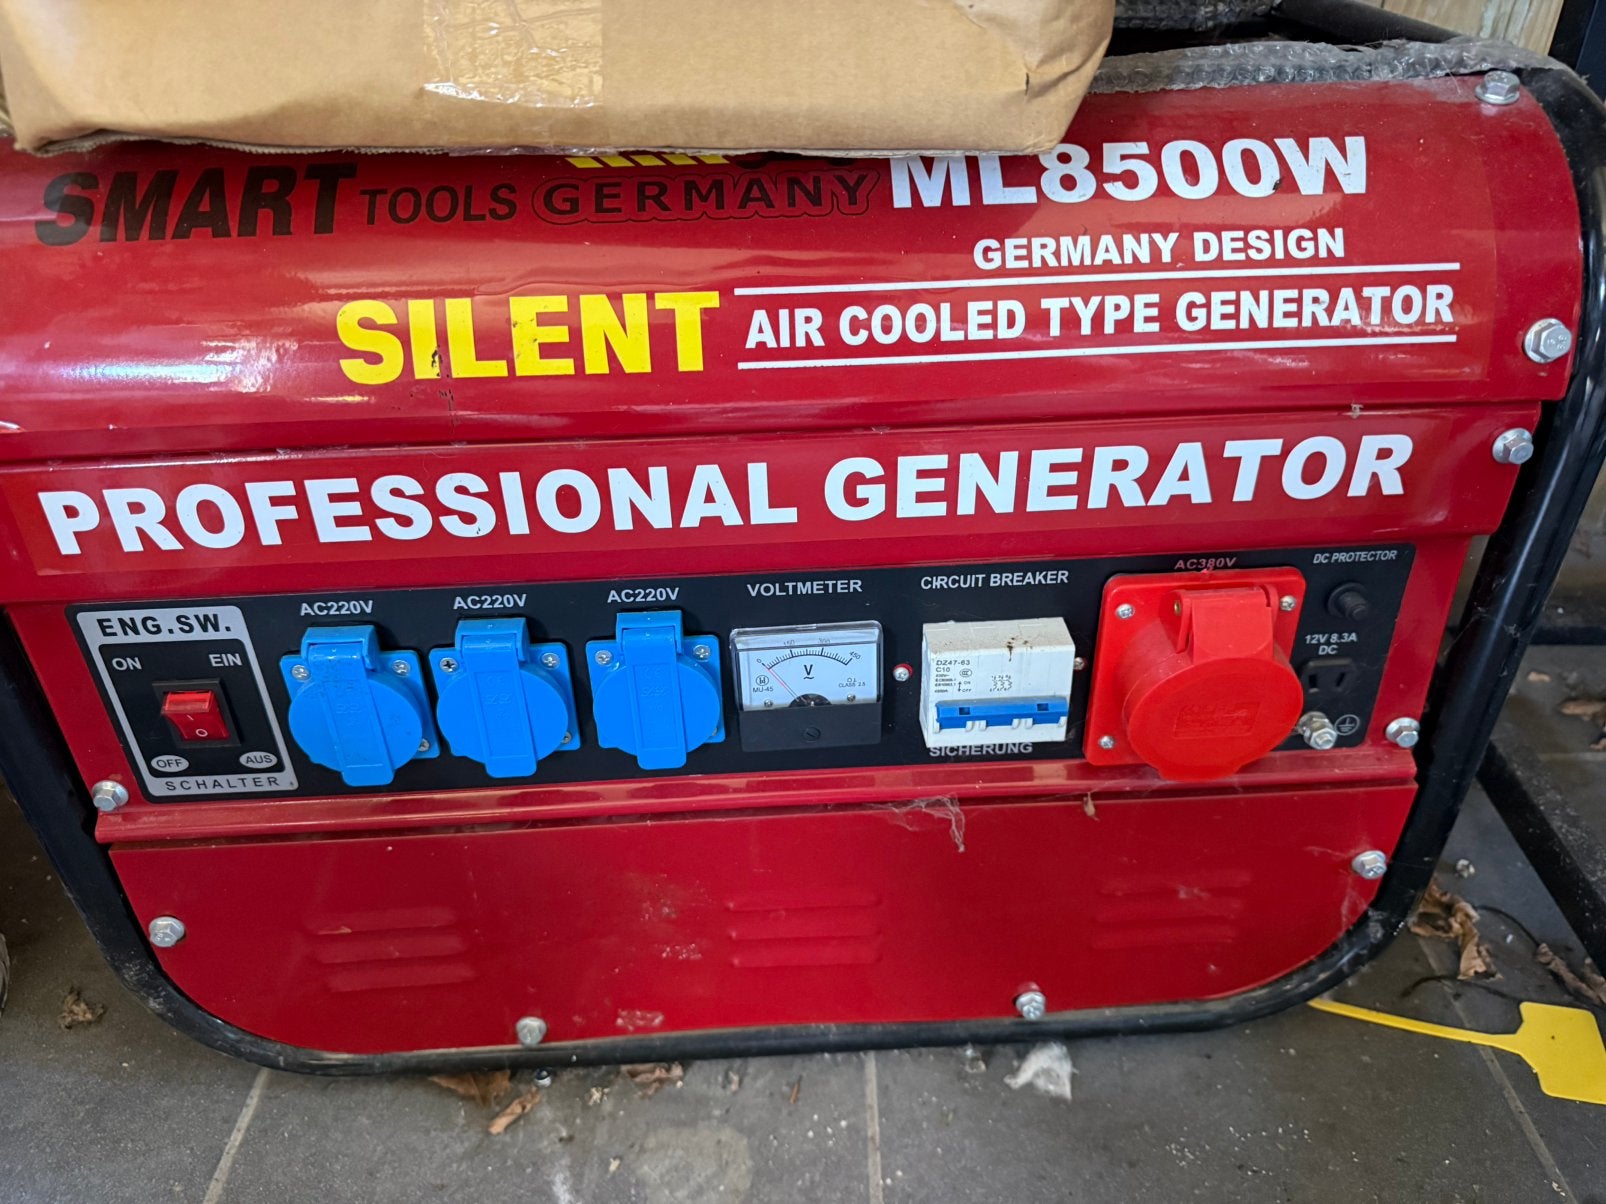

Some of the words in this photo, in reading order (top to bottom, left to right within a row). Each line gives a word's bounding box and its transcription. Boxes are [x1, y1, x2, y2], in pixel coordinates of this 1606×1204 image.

[890, 136, 1367, 208] ML8500W
[35, 163, 358, 246] SMART
[360, 183, 518, 225] TOOLS
[543, 173, 868, 216] GERMANY
[973, 232, 1179, 270] GERMANY
[1194, 227, 1345, 262] DESIGN
[745, 308, 825, 349] AIR
[839, 299, 1026, 346] COOLED
[1041, 293, 1161, 338] TYPE
[1175, 284, 1455, 332] GENERATOR
[336, 290, 720, 385] SILENT
[37, 461, 798, 556] PROFESSIONAL
[823, 433, 1413, 522] GENERATOR
[1174, 556, 1237, 570] AC380V
[1313, 552, 1330, 564] DC
[1331, 549, 1398, 563] PROTECTOR
[746, 579, 863, 597] VOLTMETER
[921, 574, 986, 590] CIRCUIT
[989, 570, 1069, 587] BREAKER
[453, 593, 528, 611] AC220V
[606, 586, 680, 604] AC220V
[299, 600, 374, 616] AC220V
[97, 612, 232, 637] ENG.SW.
[1304, 633, 1329, 645] 12V
[1330, 631, 1358, 645] 8.3A
[1318, 644, 1338, 656] DC
[112, 656, 142, 671] ON
[208, 652, 243, 668] EIN
[929, 742, 1033, 757] SICHERUNG
[156, 757, 184, 770] OFF
[244, 753, 273, 765] AUS
[165, 775, 281, 792] SCHALTER
